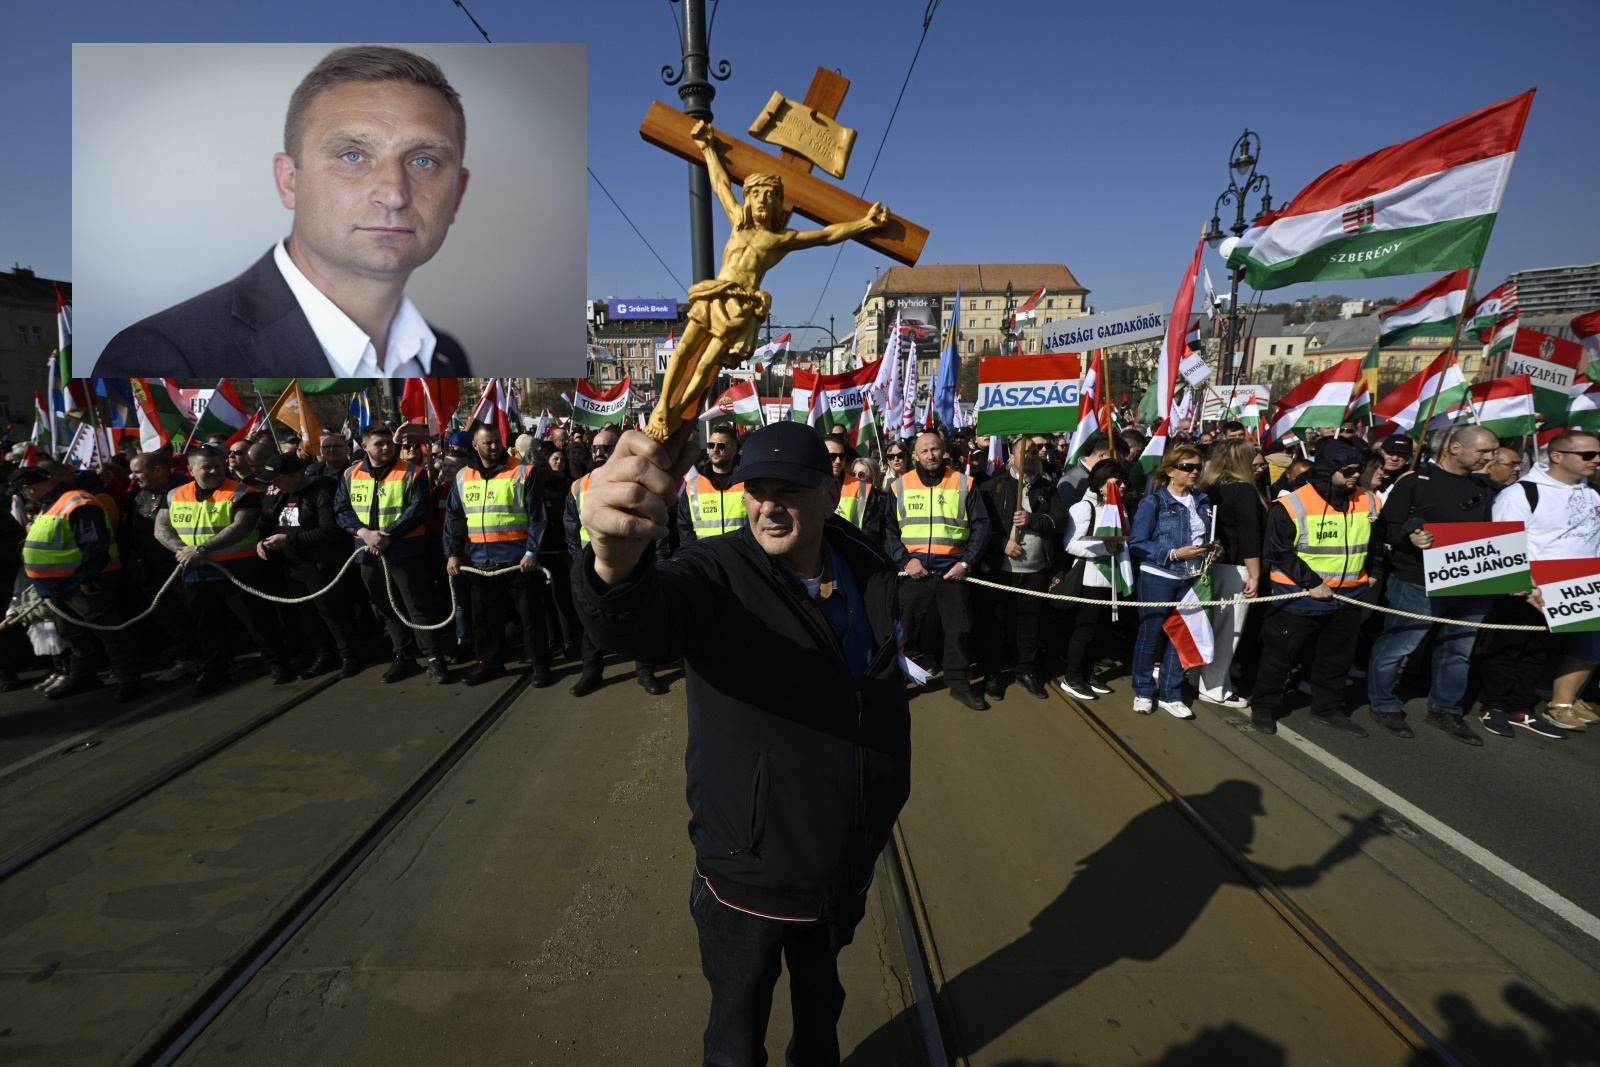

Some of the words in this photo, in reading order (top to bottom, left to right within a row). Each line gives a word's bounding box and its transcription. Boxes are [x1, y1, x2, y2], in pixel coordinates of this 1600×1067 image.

[1045, 328, 1094, 349] JÁSZSÁGI
[1183, 360, 1205, 377] BONYHÁD
[1510, 360, 1568, 386] JÁSZAPÁTI
[979, 382, 1078, 411] JÁSZSÁG
[1445, 541, 1501, 565] HAJRÁ,
[1428, 565, 1470, 583] PÓCS
[1473, 553, 1528, 574] JÁNOS!
[1546, 600, 1593, 619] PÓCS
